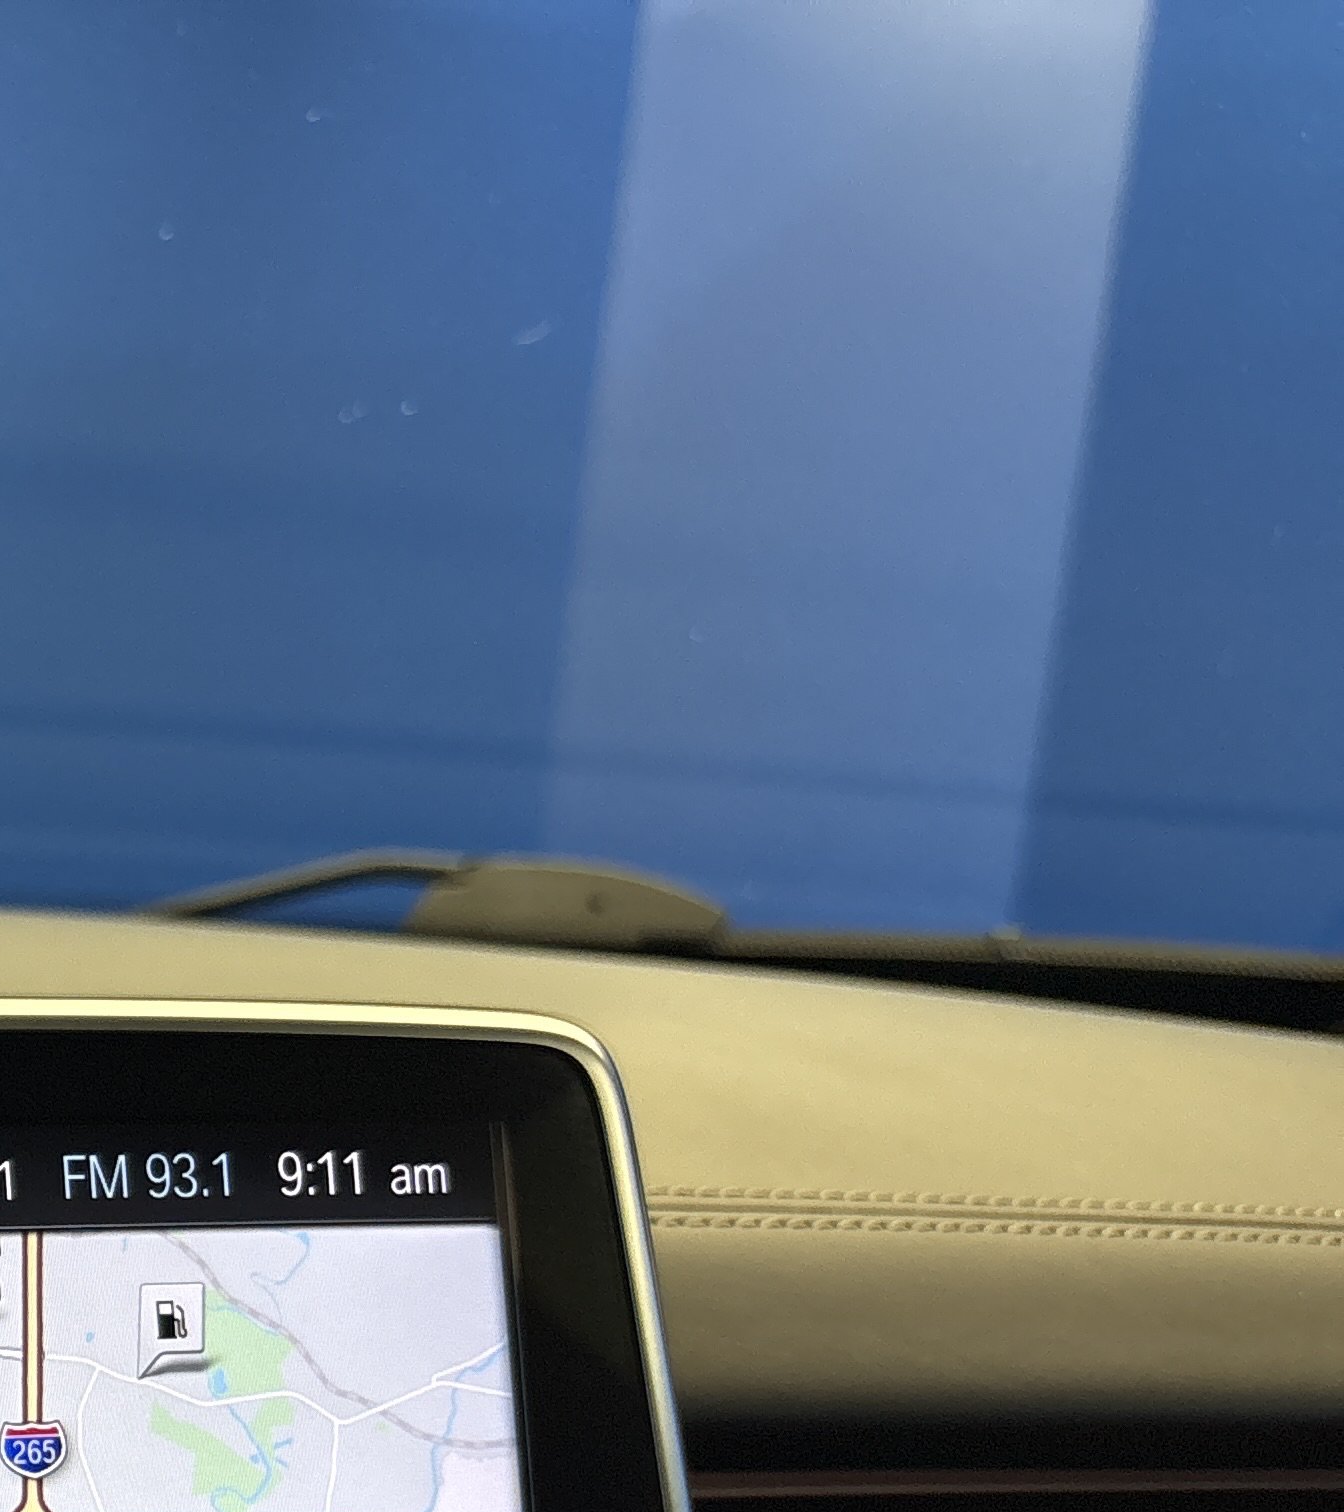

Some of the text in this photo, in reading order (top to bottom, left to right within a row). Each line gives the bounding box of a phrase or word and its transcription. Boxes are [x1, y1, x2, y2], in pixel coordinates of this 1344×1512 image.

[63, 1153, 233, 1200] FM 93.1
[277, 1151, 448, 1196] 9:11 am
[12, 1438, 57, 1465] 265
